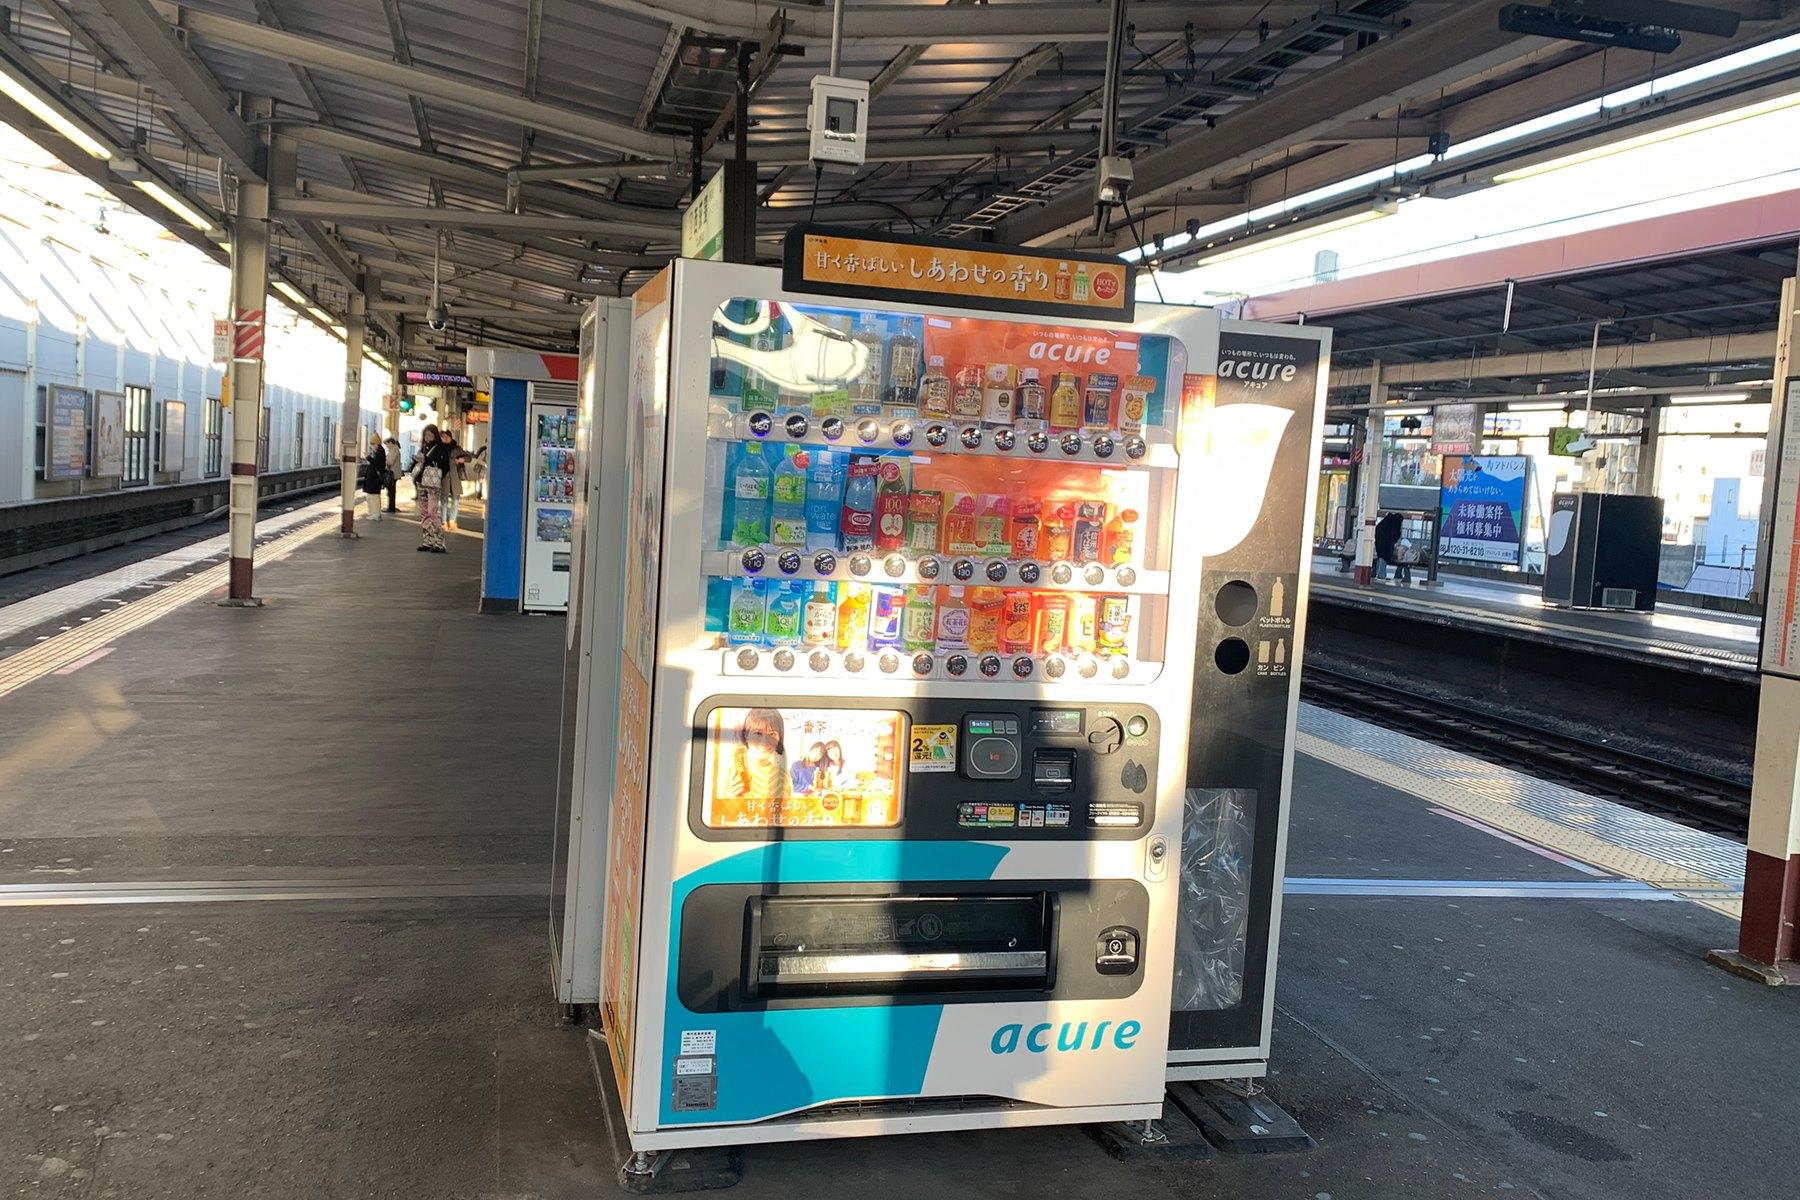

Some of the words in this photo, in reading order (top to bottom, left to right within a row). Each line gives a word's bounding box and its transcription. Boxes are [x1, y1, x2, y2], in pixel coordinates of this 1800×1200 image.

[814, 251, 904, 273] 甘く香ばしい
[910, 257, 1049, 293] しあわせの香り
[1029, 341, 1111, 365] acure
[1218, 360, 1297, 382] acure
[1243, 381, 1268, 389] アキュア
[912, 738, 930, 752] 2%
[991, 1020, 1141, 1055] acure
